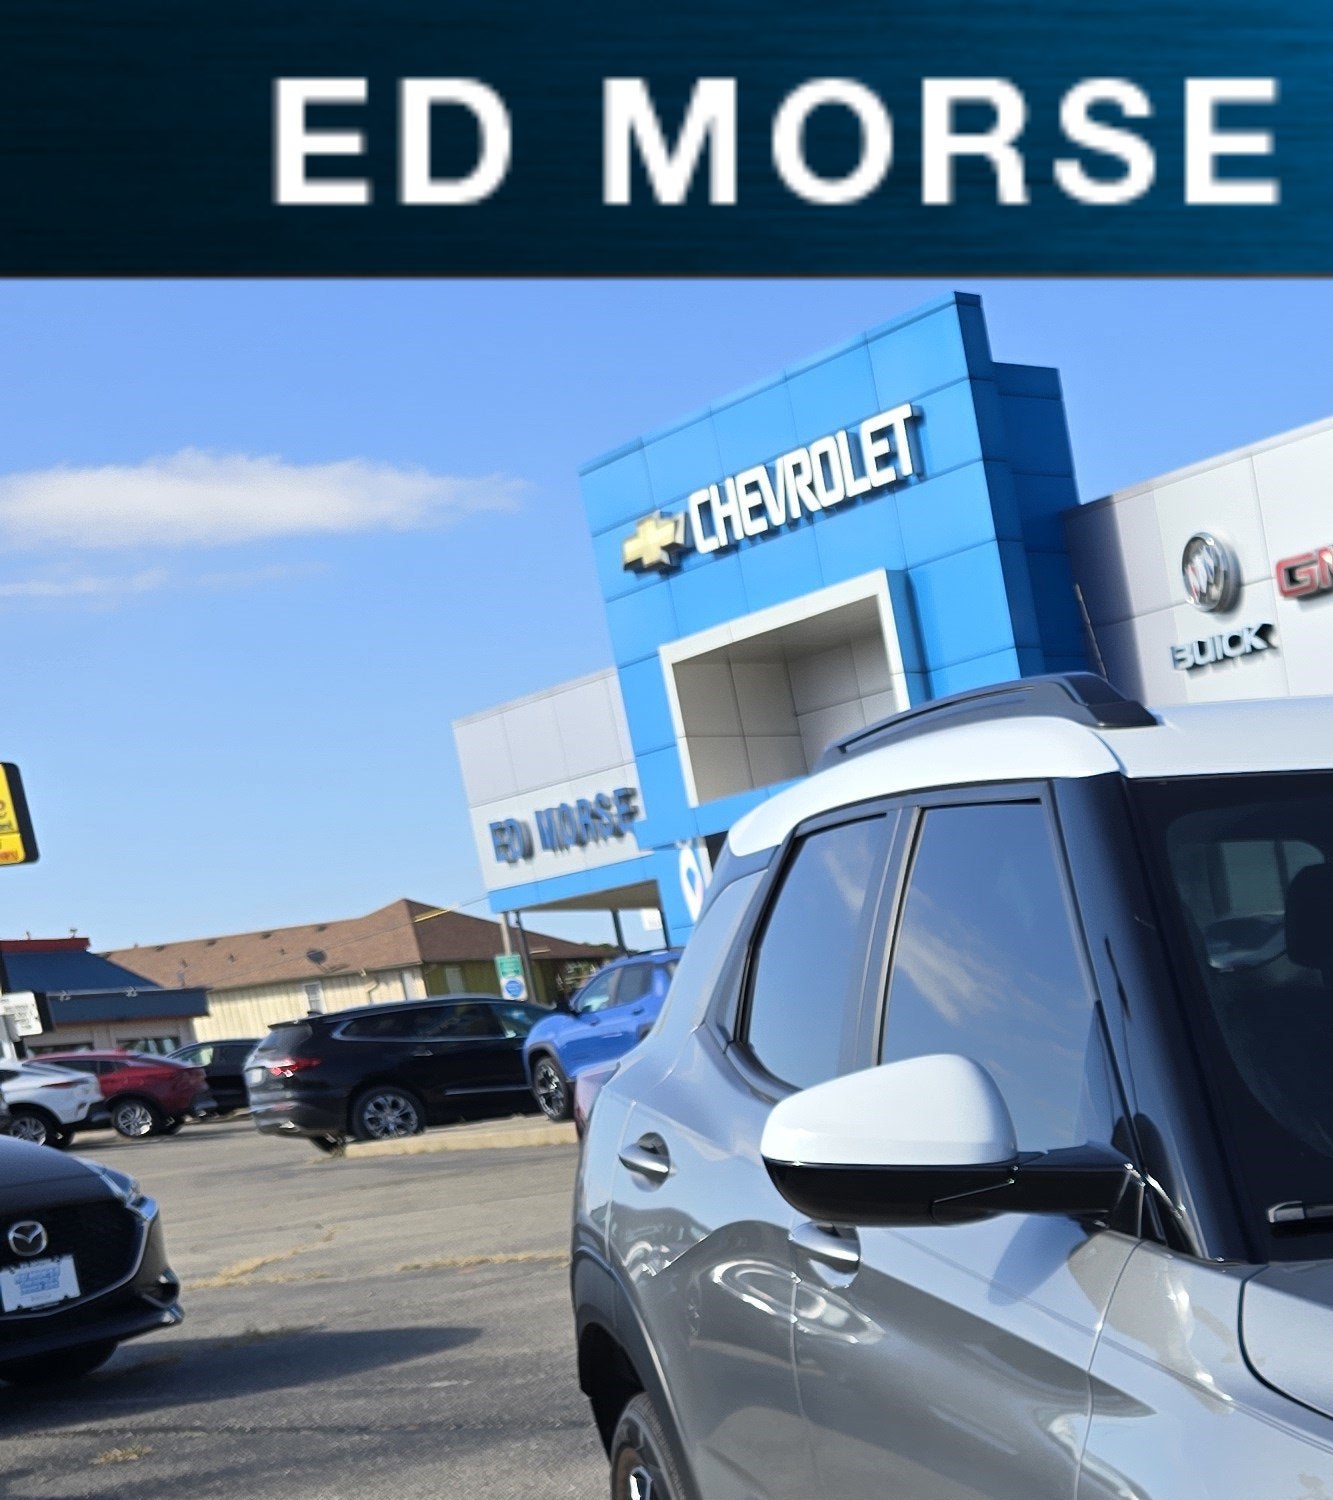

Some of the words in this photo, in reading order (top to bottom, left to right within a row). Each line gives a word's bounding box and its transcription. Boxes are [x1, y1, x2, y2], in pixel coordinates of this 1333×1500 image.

[687, 402, 917, 555] CHEVROLET
[1170, 623, 1273, 671] BUICK
[489, 818, 533, 864] ED
[534, 787, 638, 852] MORSE
